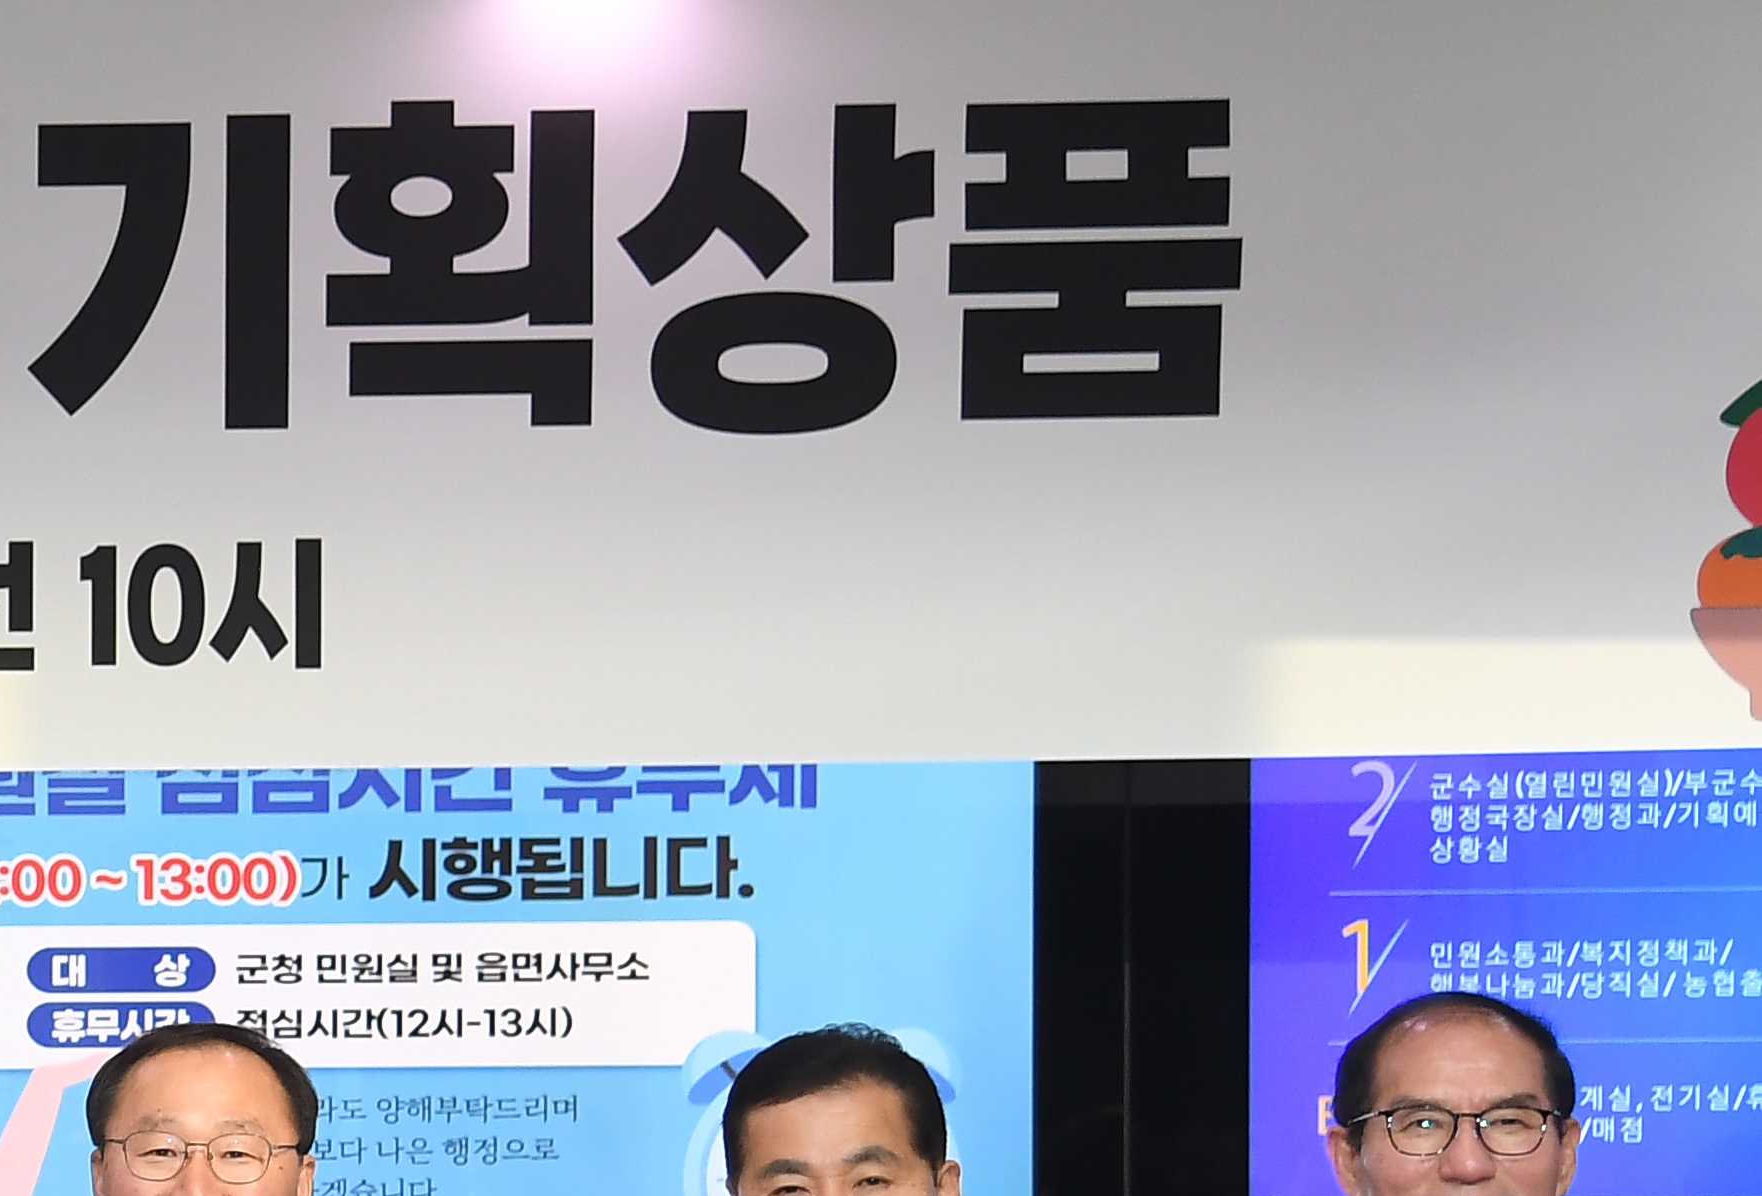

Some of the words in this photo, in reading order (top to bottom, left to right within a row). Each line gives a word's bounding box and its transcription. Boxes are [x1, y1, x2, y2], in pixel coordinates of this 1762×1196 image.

[28, 99, 1242, 434] 기획상품
[81, 539, 321, 668] 10시
[1429, 834, 1509, 864] 상황실
[134, 853, 349, 905] 13:00)가
[369, 836, 756, 902] 시행됩니다.
[50, 952, 89, 988] 대
[152, 952, 192, 988] 상
[235, 953, 303, 985] 군청
[317, 953, 419, 985] 민원실
[431, 953, 465, 985] 및
[475, 952, 651, 984] 읍면사무소
[376, 1096, 578, 1123] 양해부탁드리며
[377, 1138, 434, 1163] 나은
[442, 1138, 560, 1163] 행정으로
